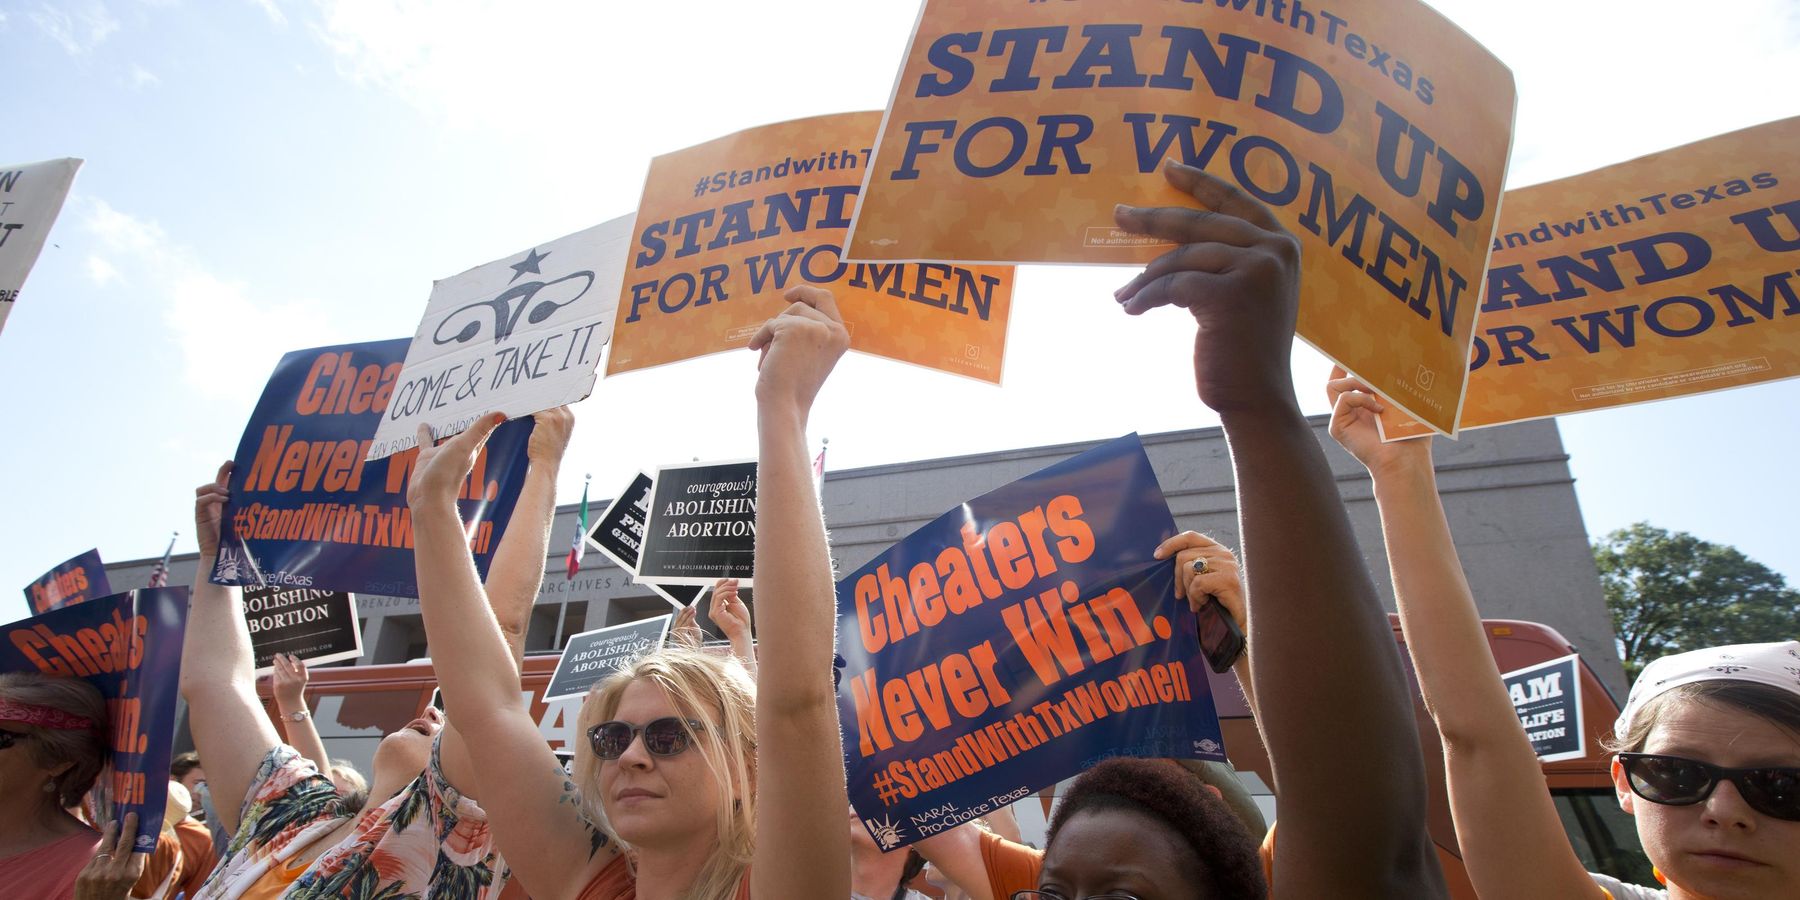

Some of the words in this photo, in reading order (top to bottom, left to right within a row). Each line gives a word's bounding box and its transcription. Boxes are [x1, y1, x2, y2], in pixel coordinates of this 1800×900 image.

[914, 23, 1344, 134] STAND
[1375, 101, 1485, 238] UP
[890, 112, 1094, 181] FOR
[1123, 112, 1469, 338] WOMEN
[1492, 170, 1779, 251] andwithTexas
[625, 263, 729, 324] FOR
[744, 244, 1001, 322] WOMEN
[1481, 230, 1713, 312] AND
[1552, 271, 1800, 354] WOM
[296, 352, 405, 415] Chea
[391, 365, 463, 421] COME
[455, 358, 484, 401] &
[490, 334, 563, 390] TAKE
[558, 321, 602, 371] IT.
[243, 425, 377, 492] Never
[663, 498, 756, 516] ABOLISHIN
[687, 475, 754, 497] courageously
[619, 513, 645, 537] PR
[666, 521, 756, 537] ABORTION
[279, 571, 313, 586] Texas
[854, 494, 1095, 654] Cheaters
[242, 588, 334, 614] BOLISHIN
[249, 604, 329, 633] BORTION
[570, 637, 650, 662] ABOLISHING
[590, 630, 639, 648] courageously
[850, 641, 1011, 757] Never
[1001, 580, 1172, 686] Win.
[1509, 672, 1563, 706] AM
[107, 680, 147, 754] in.
[873, 661, 1190, 806] #StandWithTxWomen
[1521, 709, 1565, 729] LIFE
[1527, 727, 1565, 741] ATION
[910, 802, 959, 826] NARAL
[918, 804, 990, 837] Pro-Choice
[988, 785, 1030, 807] Texas
